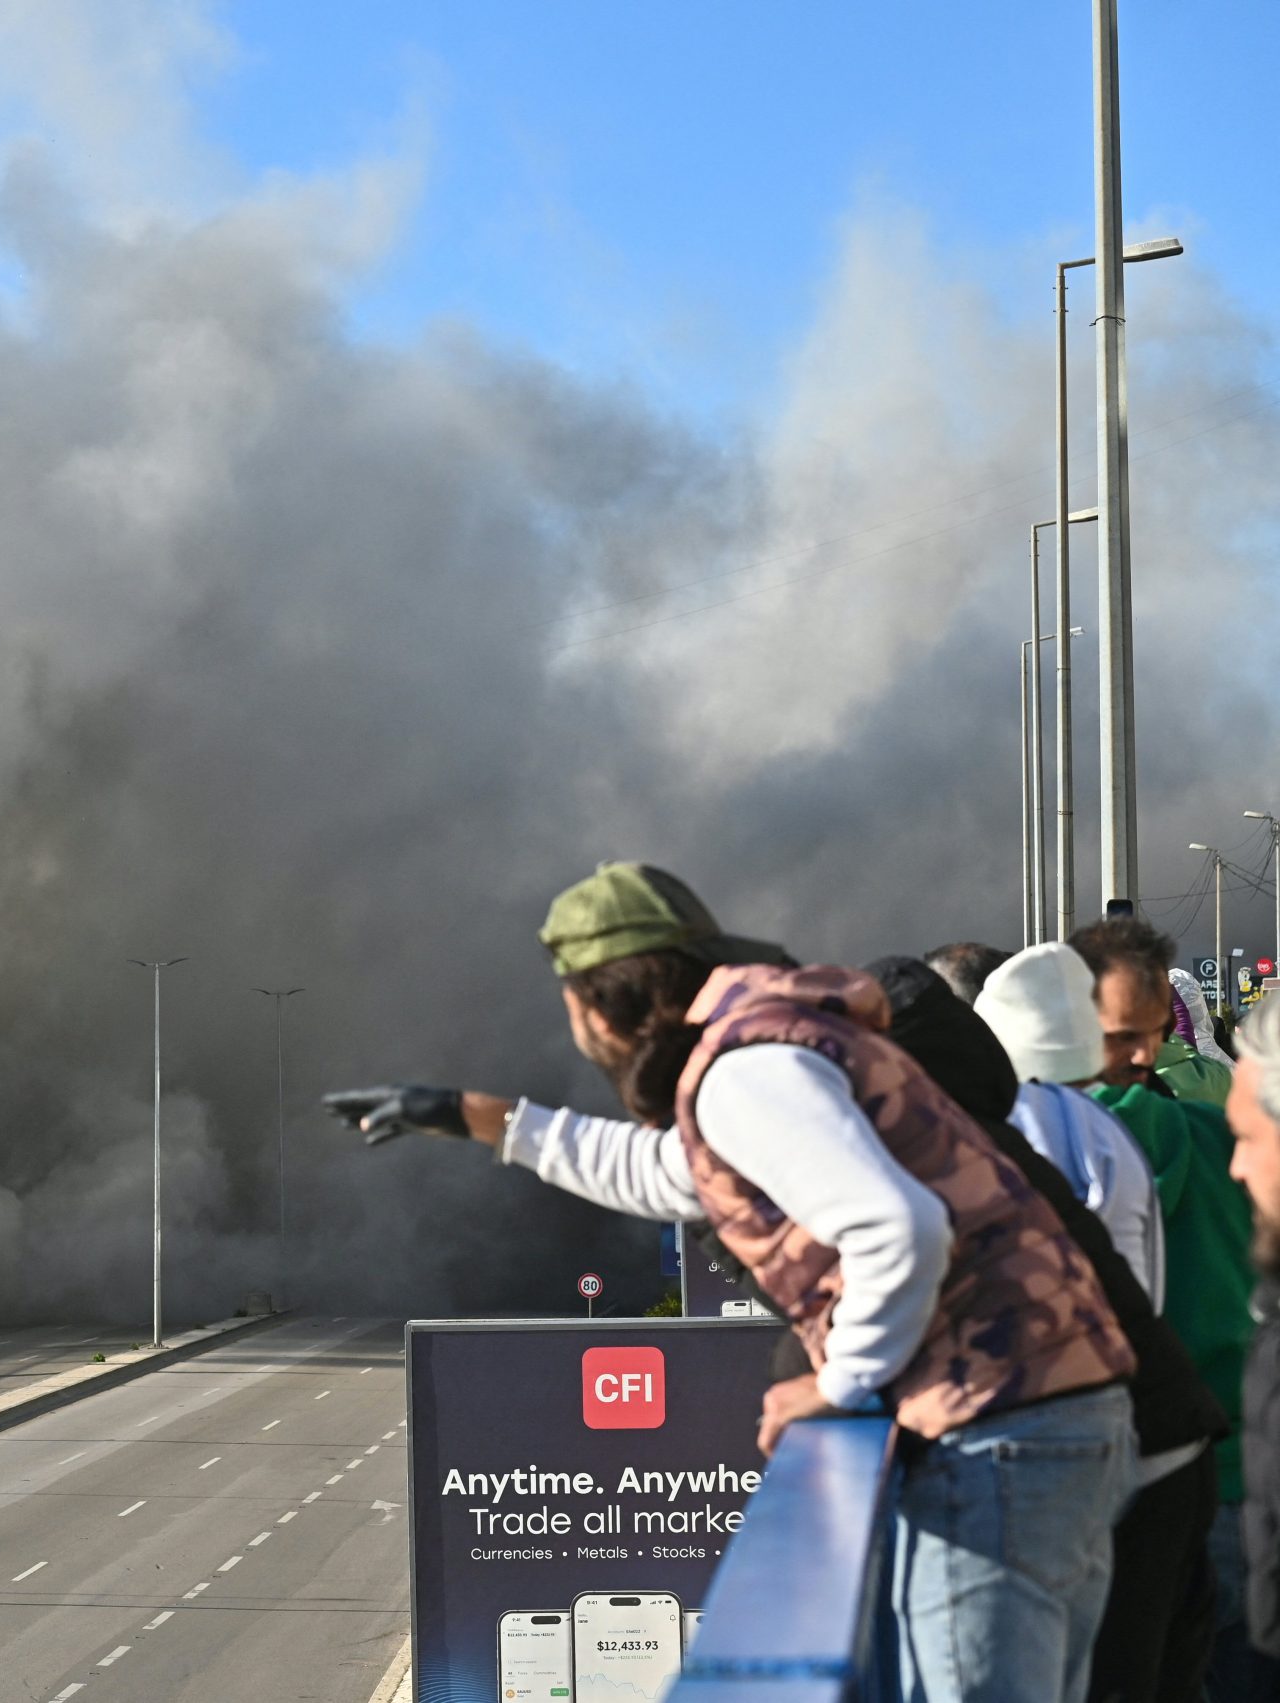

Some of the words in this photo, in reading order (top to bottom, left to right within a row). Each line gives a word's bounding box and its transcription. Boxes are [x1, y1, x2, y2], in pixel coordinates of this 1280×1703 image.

[583, 1280, 598, 1291] 80
[594, 1374, 653, 1403] CFI
[442, 1465, 605, 1504] Anytime.
[616, 1464, 767, 1502] Anywhe
[468, 1505, 572, 1535] Trade
[583, 1505, 621, 1534] all
[634, 1503, 747, 1534] marke
[470, 1546, 553, 1561] Currencies
[577, 1546, 628, 1560] Metals
[652, 1545, 706, 1559] Stocks
[597, 1640, 659, 1653] $12,433.93
